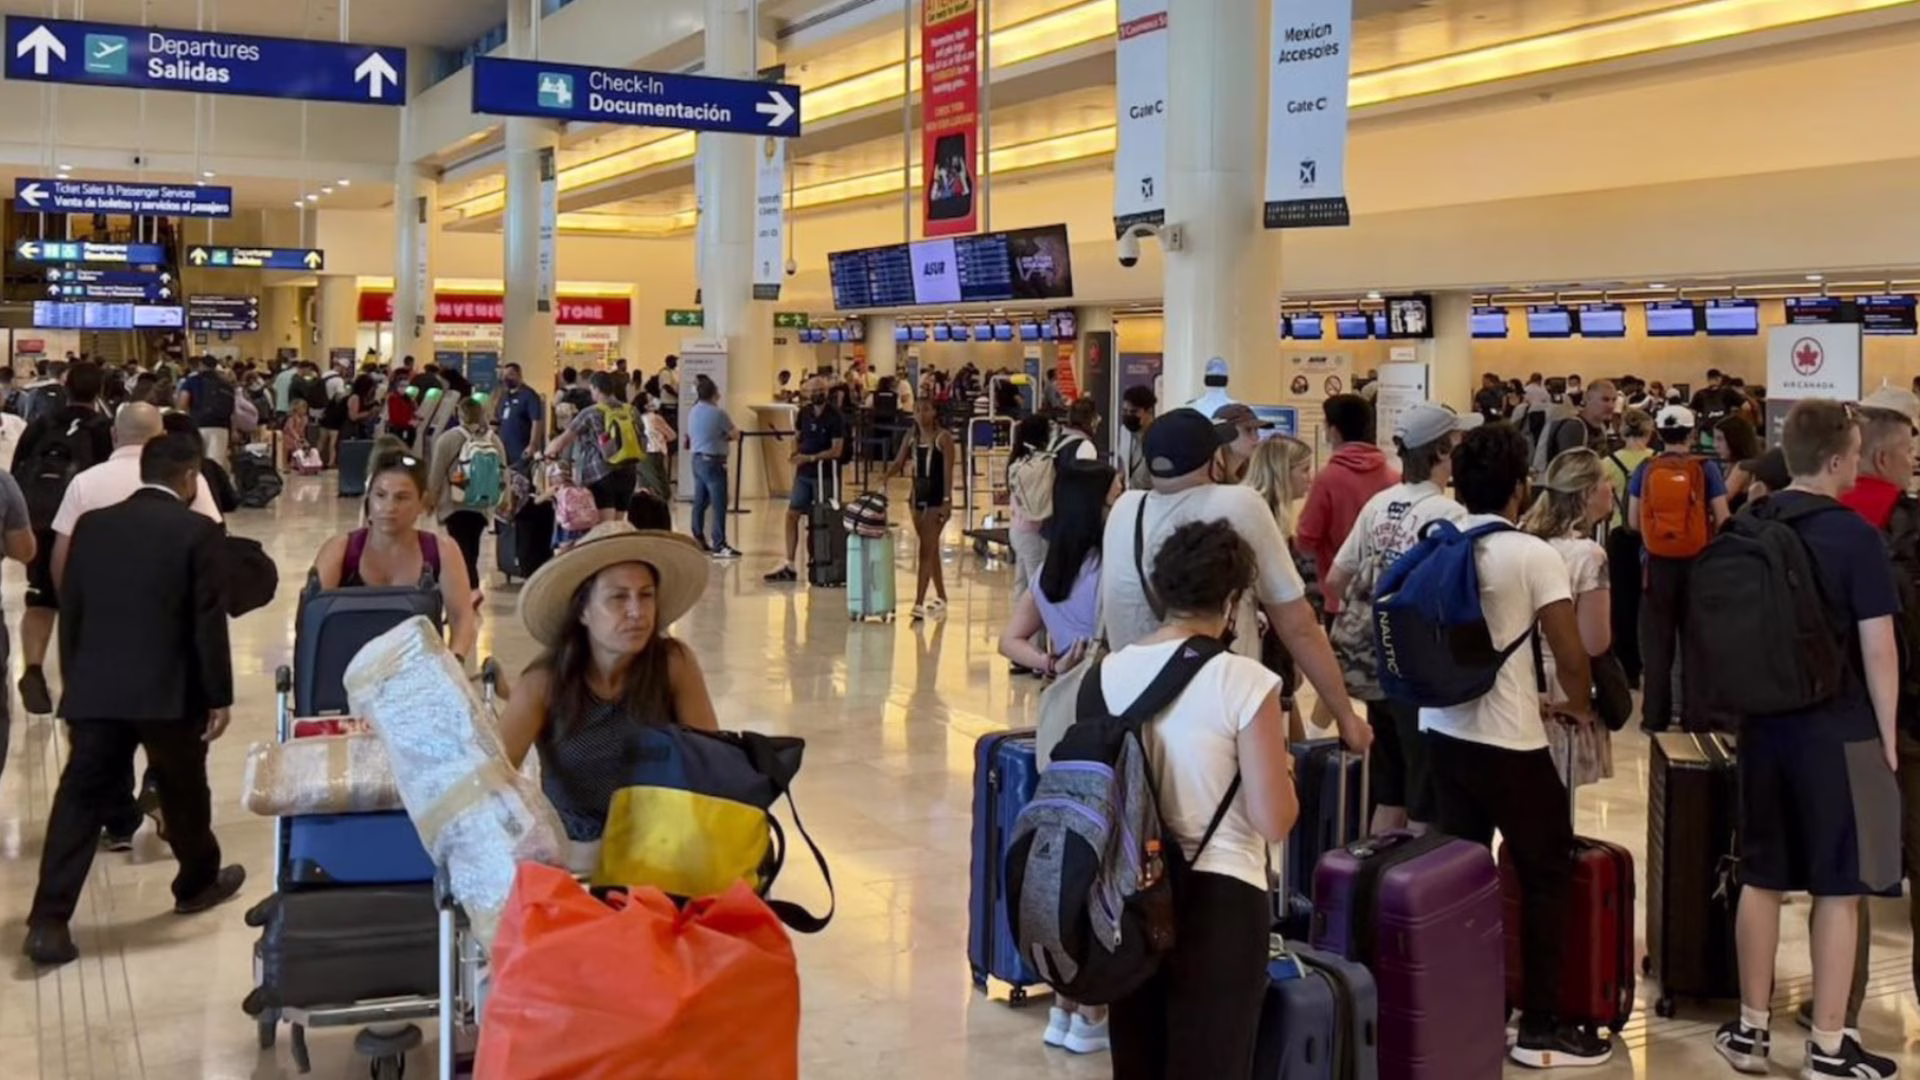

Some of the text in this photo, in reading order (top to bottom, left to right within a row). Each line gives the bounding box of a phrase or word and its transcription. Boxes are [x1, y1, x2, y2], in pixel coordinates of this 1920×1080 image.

[148, 32, 260, 61] Departures
[147, 57, 231, 83] Salidas
[589, 70, 665, 95] Check-In
[589, 92, 732, 122] Documentación
[1129, 104, 1154, 120] Gate
[1286, 98, 1314, 115] Gate
[53, 194, 83, 208] Venta
[160, 186, 197, 199] Services
